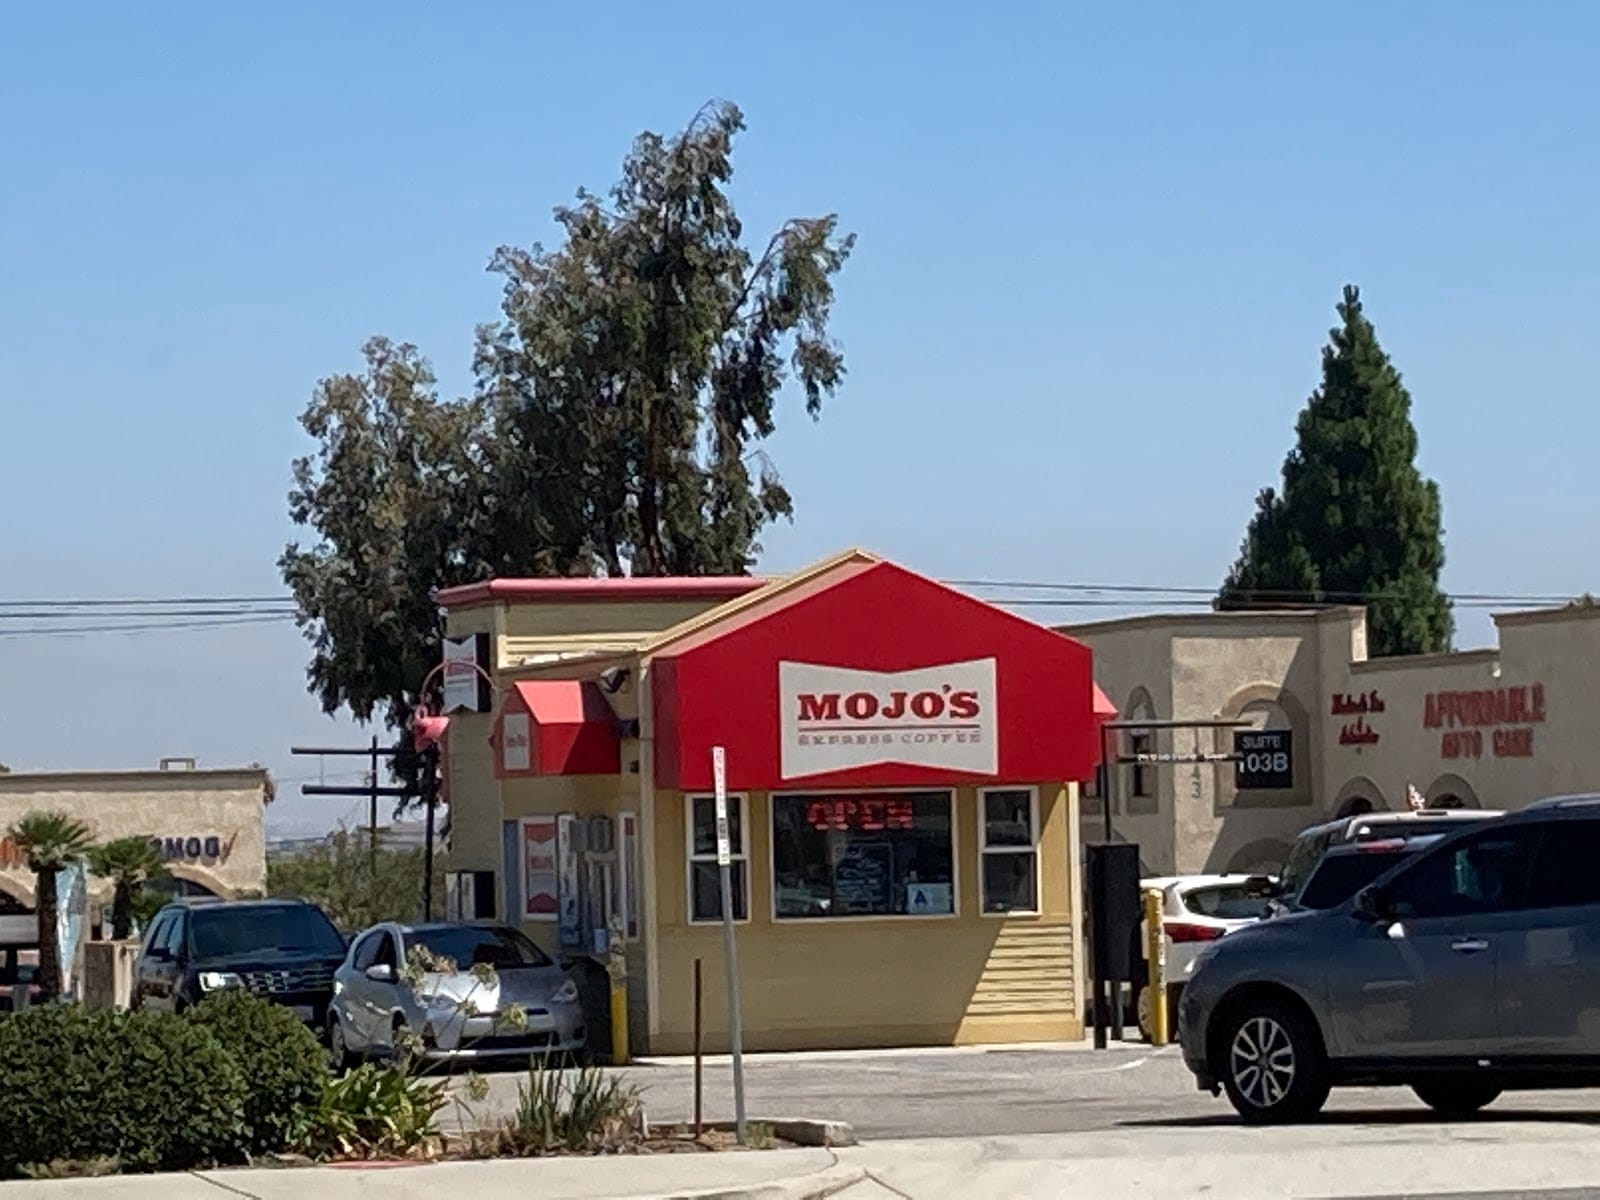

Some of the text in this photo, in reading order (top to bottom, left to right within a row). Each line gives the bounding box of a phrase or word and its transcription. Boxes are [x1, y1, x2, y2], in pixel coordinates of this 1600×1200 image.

[797, 684, 980, 721] MOJO'S
[798, 731, 980, 746] EXPRESS COFFEE
[1242, 735, 1281, 749] SUITE
